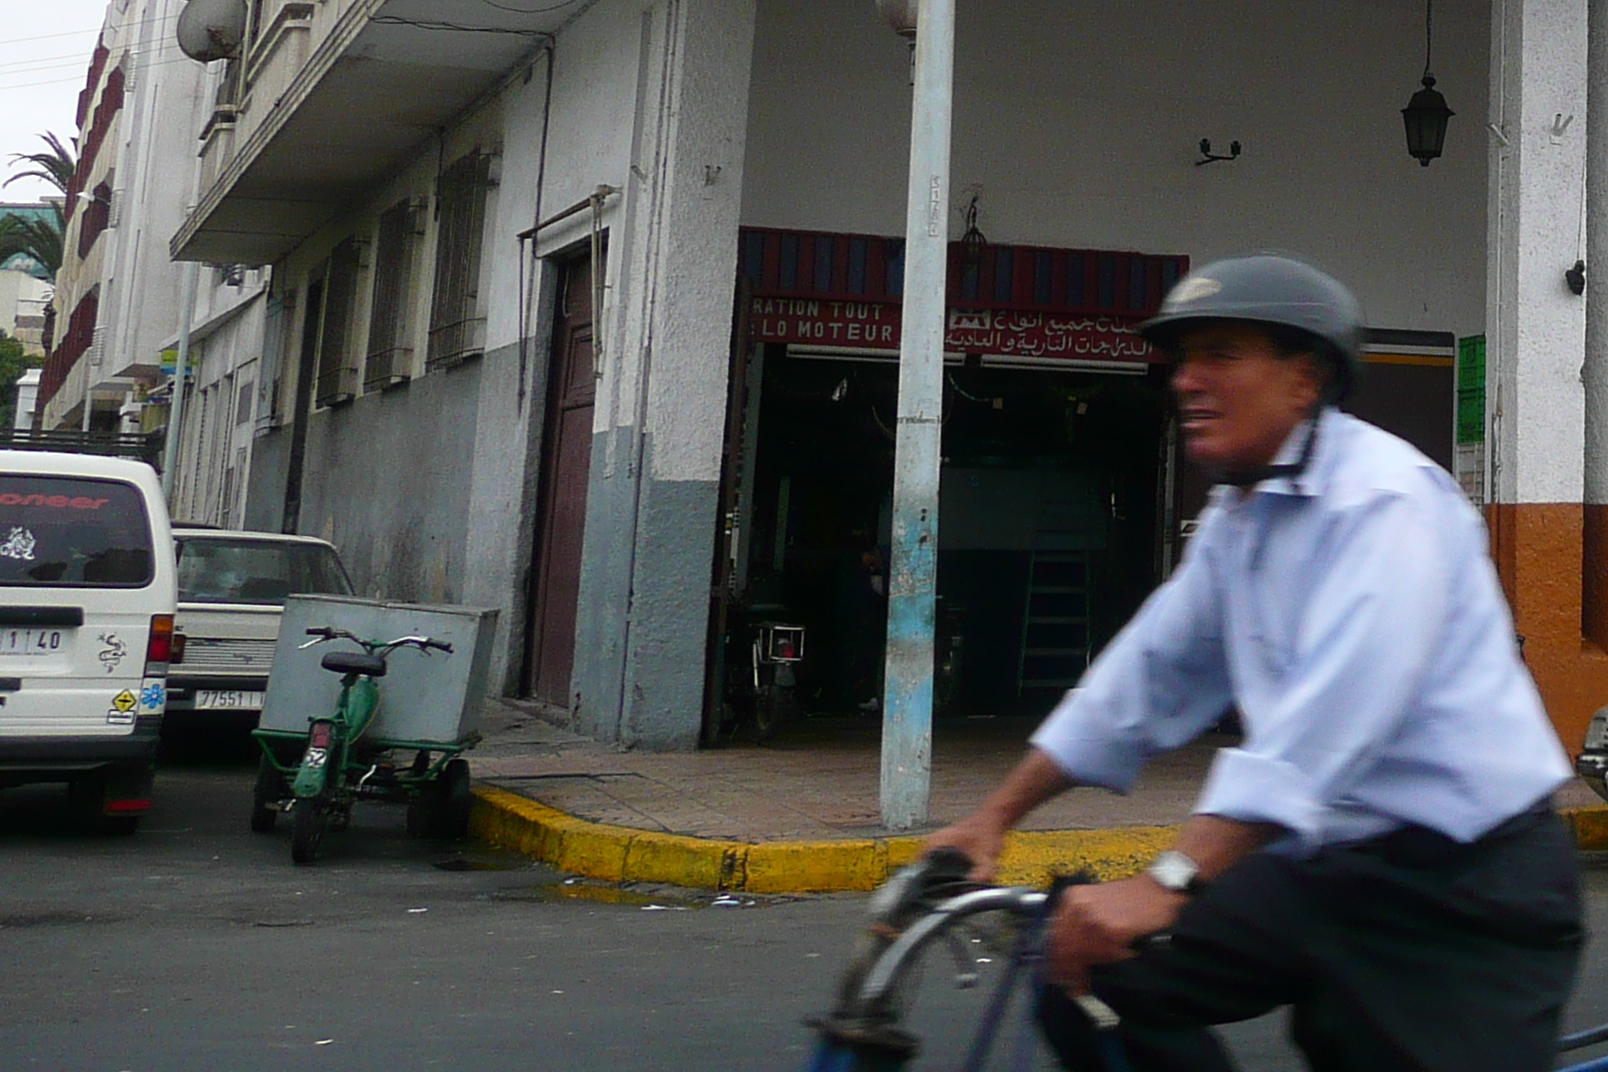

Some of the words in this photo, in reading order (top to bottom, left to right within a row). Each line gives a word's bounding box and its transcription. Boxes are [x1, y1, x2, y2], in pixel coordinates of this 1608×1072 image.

[752, 297, 819, 317] RATION
[830, 302, 885, 321] TOUT
[751, 319, 788, 337] LO
[797, 320, 893, 342] MOTEUR
[37, 631, 60, 649] 40
[202, 691, 243, 708] 77551
